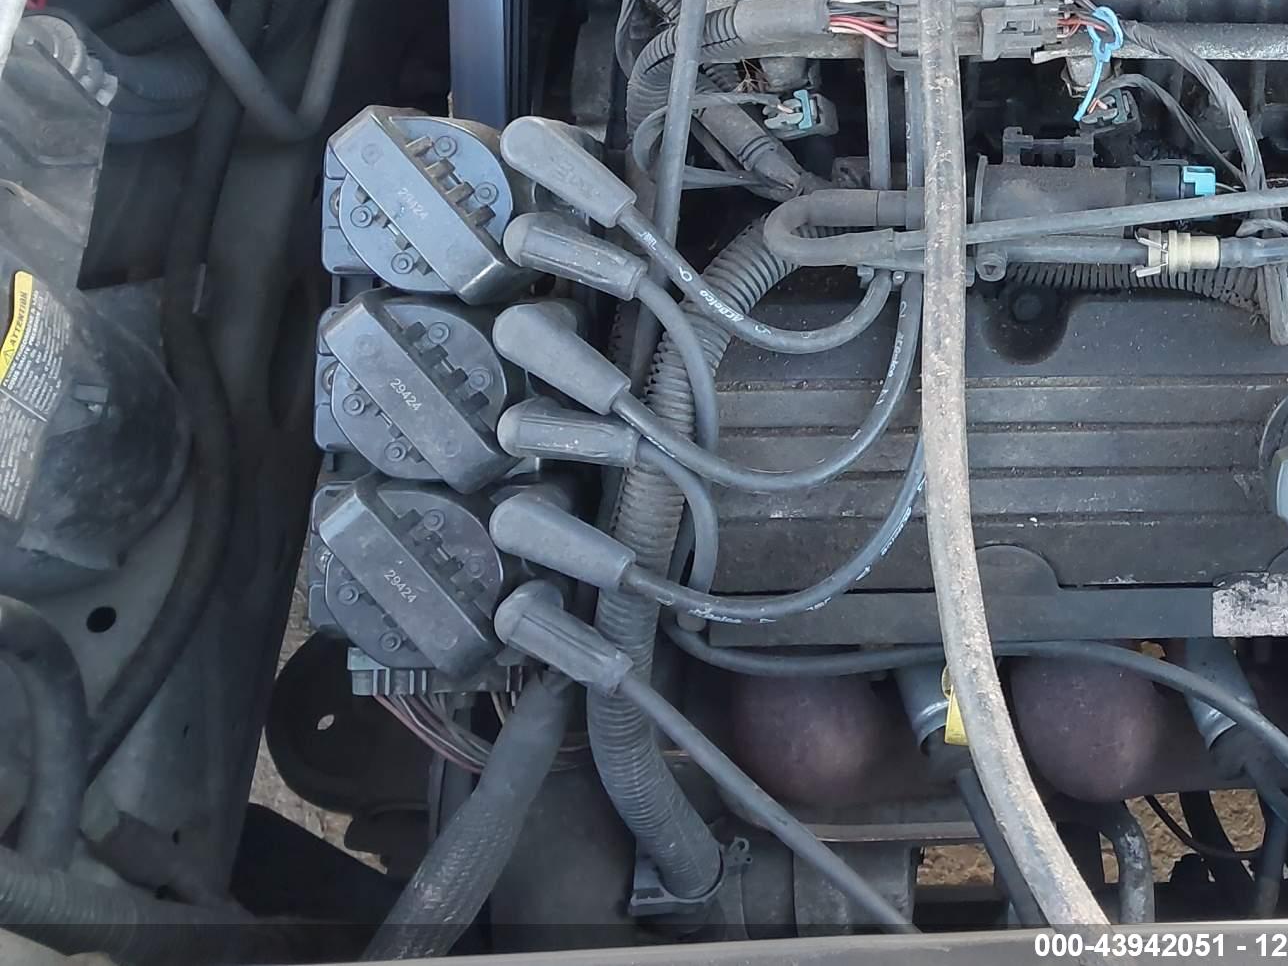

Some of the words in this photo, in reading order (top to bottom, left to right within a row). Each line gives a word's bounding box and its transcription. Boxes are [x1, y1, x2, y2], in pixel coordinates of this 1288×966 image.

[10, 291, 27, 346] ATTENTION
[390, 378, 422, 411] 29424
[384, 569, 417, 602] 29424
